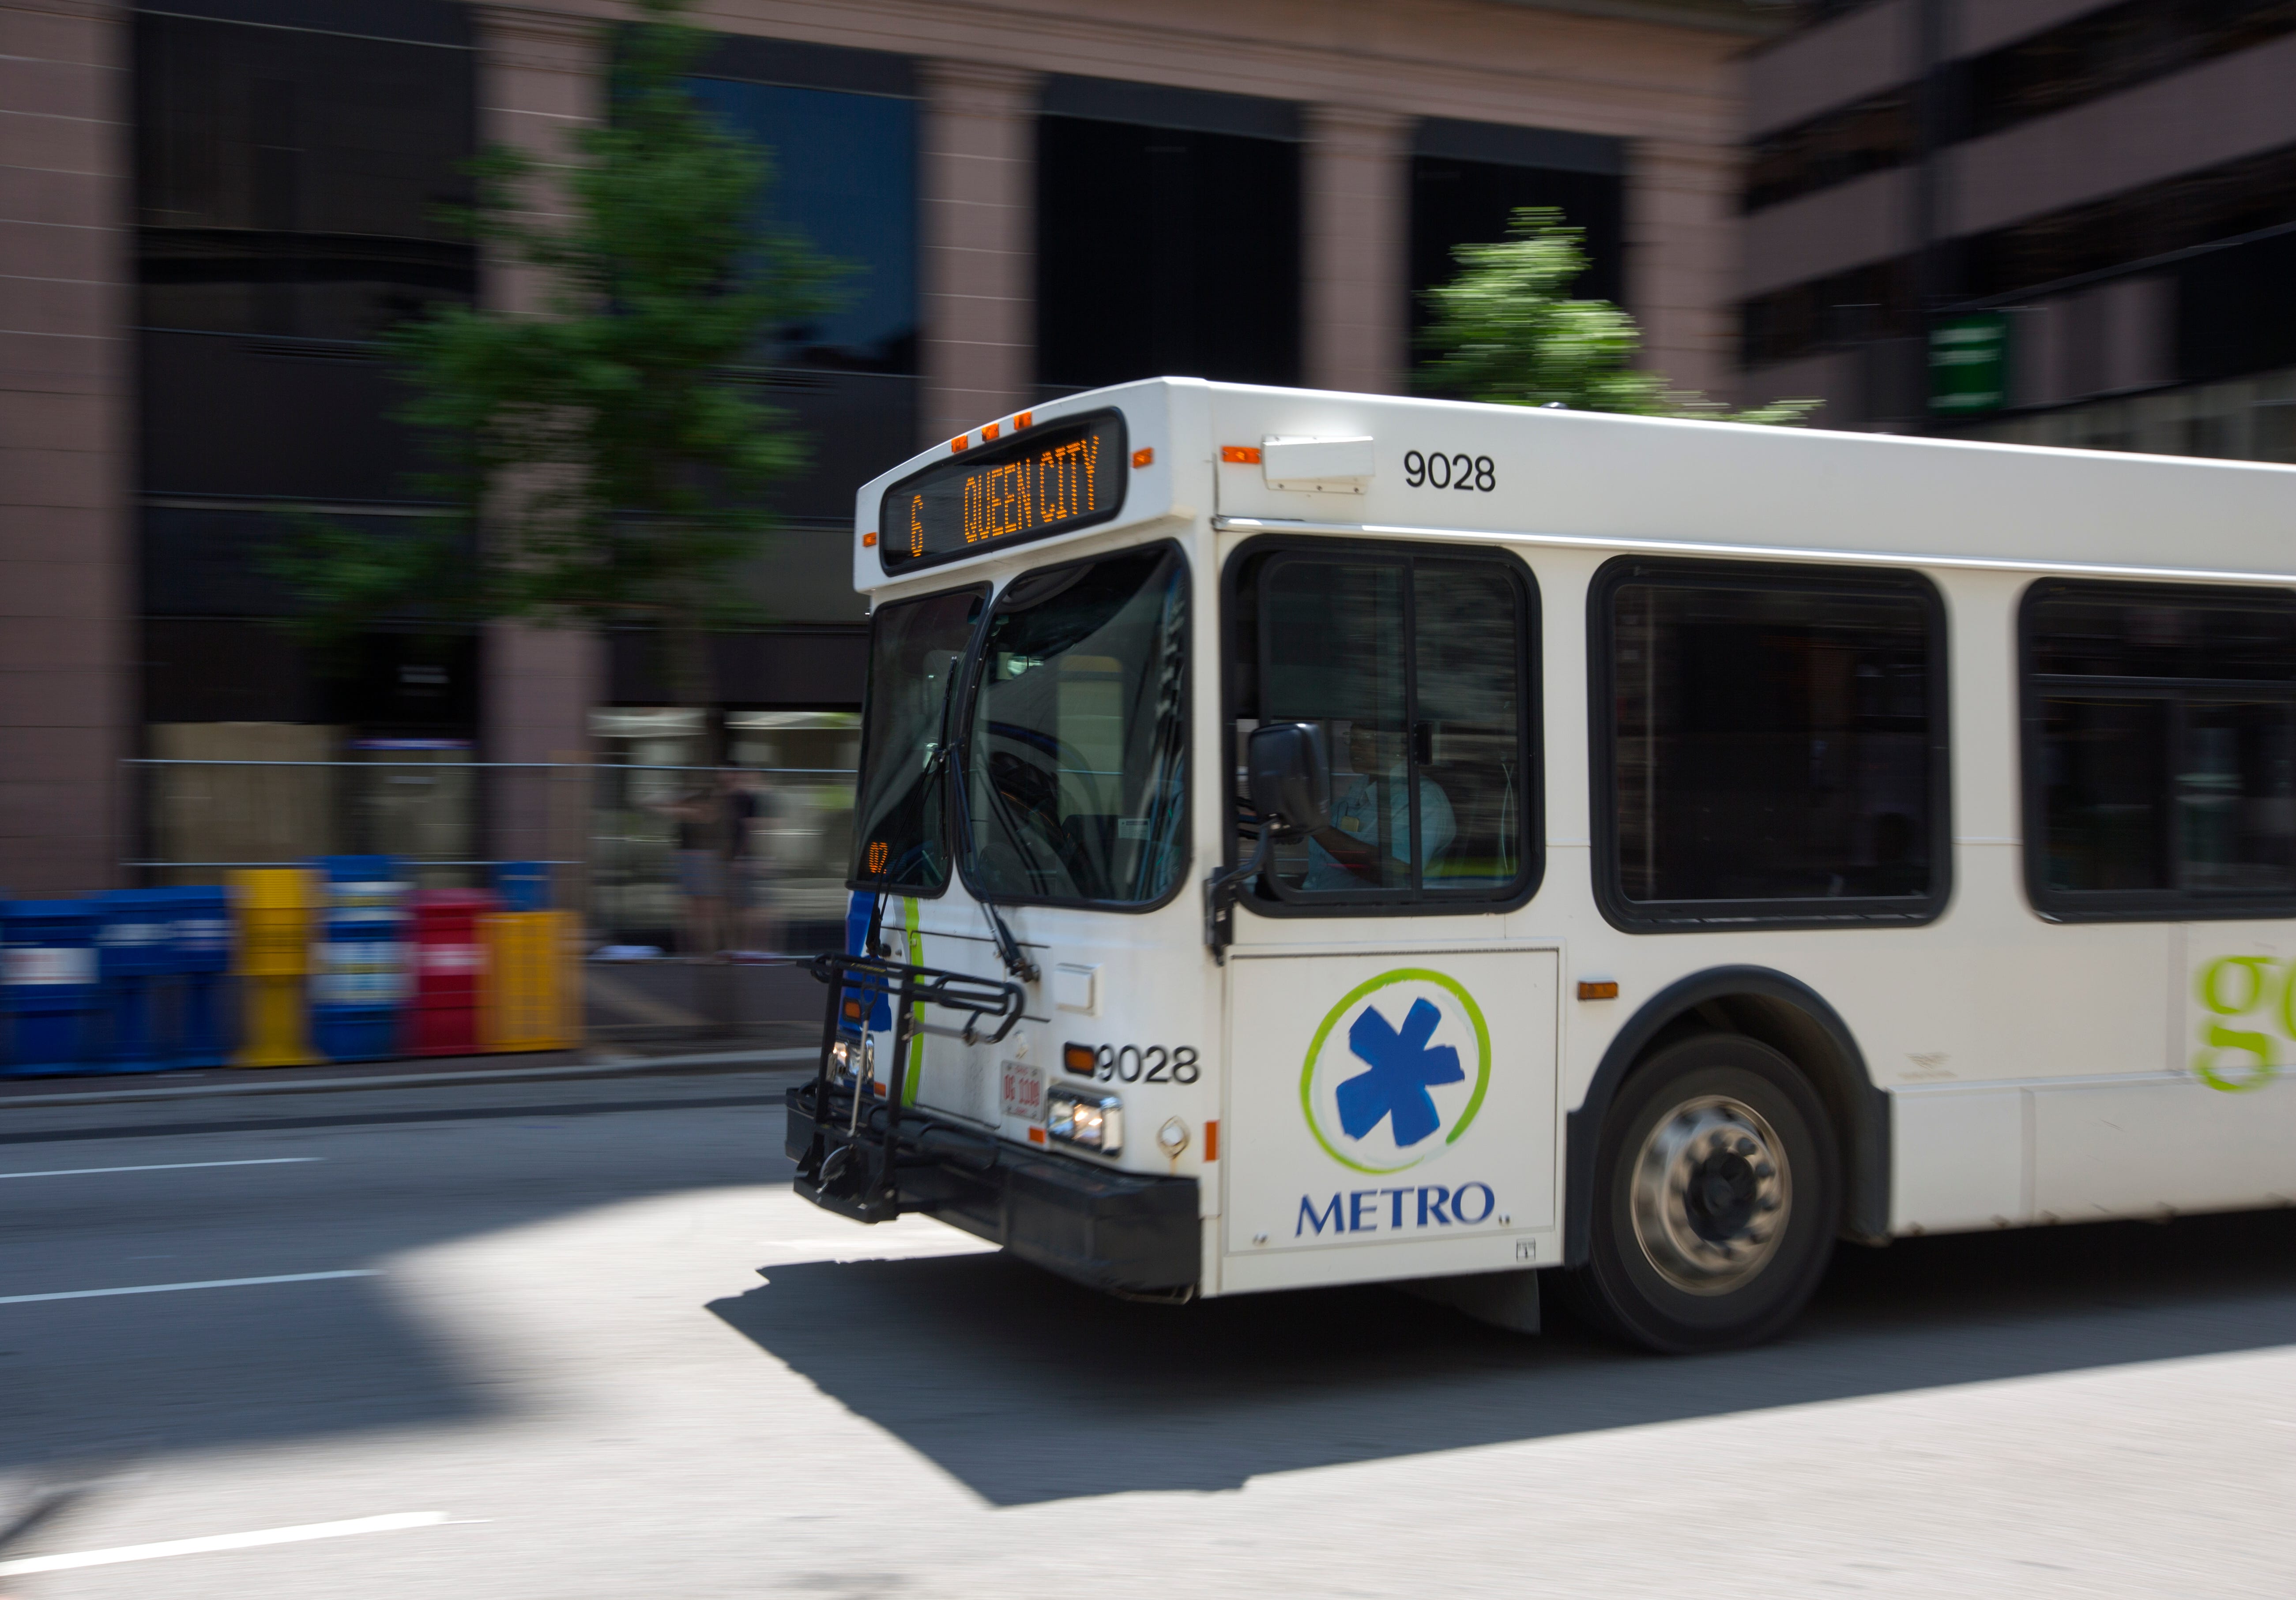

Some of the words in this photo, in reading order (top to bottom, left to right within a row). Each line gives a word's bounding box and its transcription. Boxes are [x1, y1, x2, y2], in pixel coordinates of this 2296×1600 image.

[911, 494, 923, 557] 6
[964, 457, 1032, 543] QUEEN
[1039, 434, 1099, 523] CITY
[1404, 450, 1496, 492] 9028
[1095, 1043, 1201, 1085] 9028
[1294, 1181, 1495, 1238] METRO
